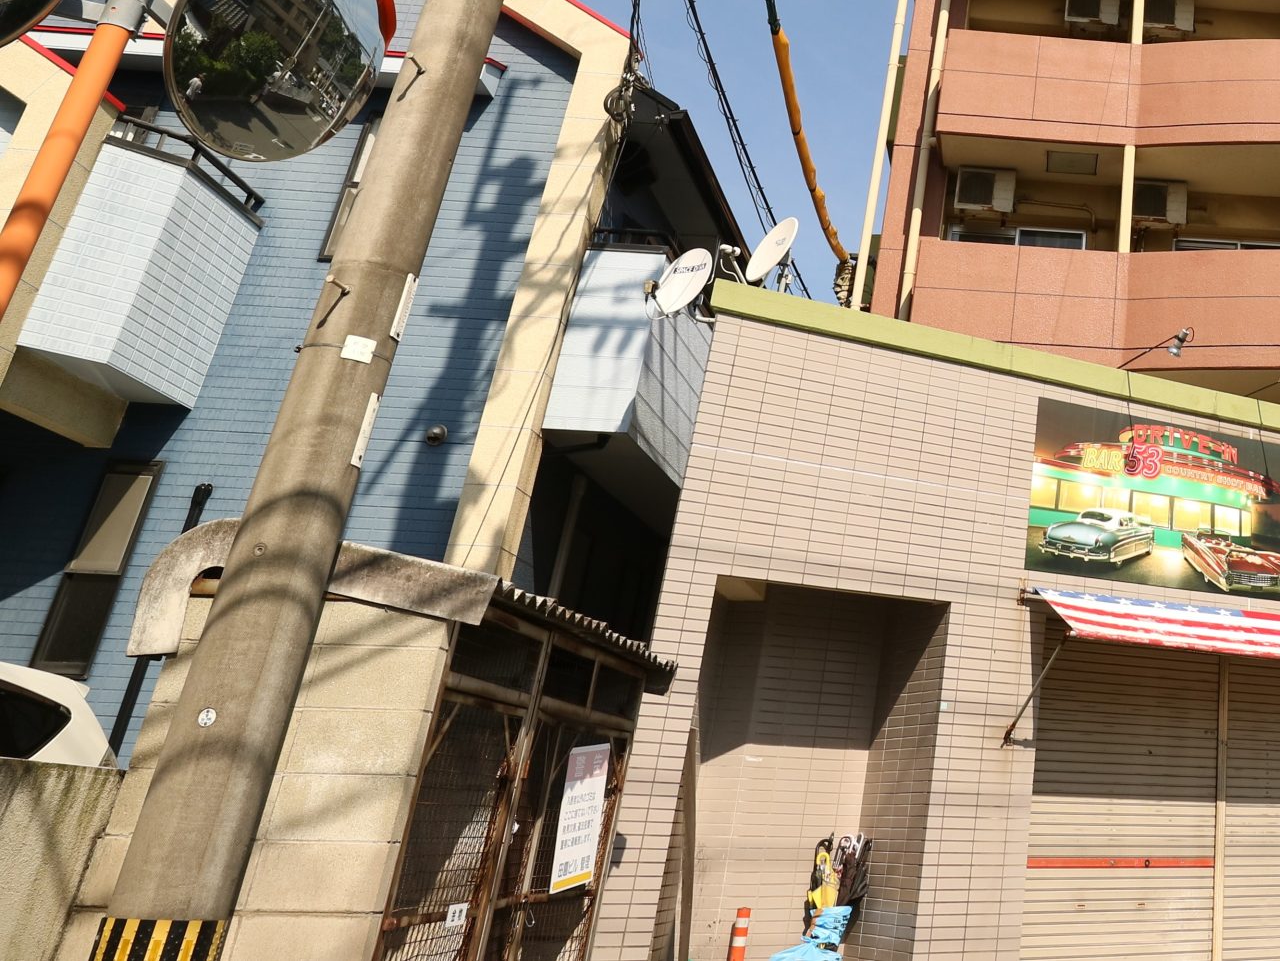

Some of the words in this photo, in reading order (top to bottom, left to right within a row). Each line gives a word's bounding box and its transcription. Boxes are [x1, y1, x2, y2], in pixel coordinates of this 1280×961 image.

[1082, 446, 1122, 472] BAR
[1124, 443, 1164, 479] 53
[1133, 424, 1239, 465] DRIVE-IN
[1164, 464, 1215, 483] COUNTRY
